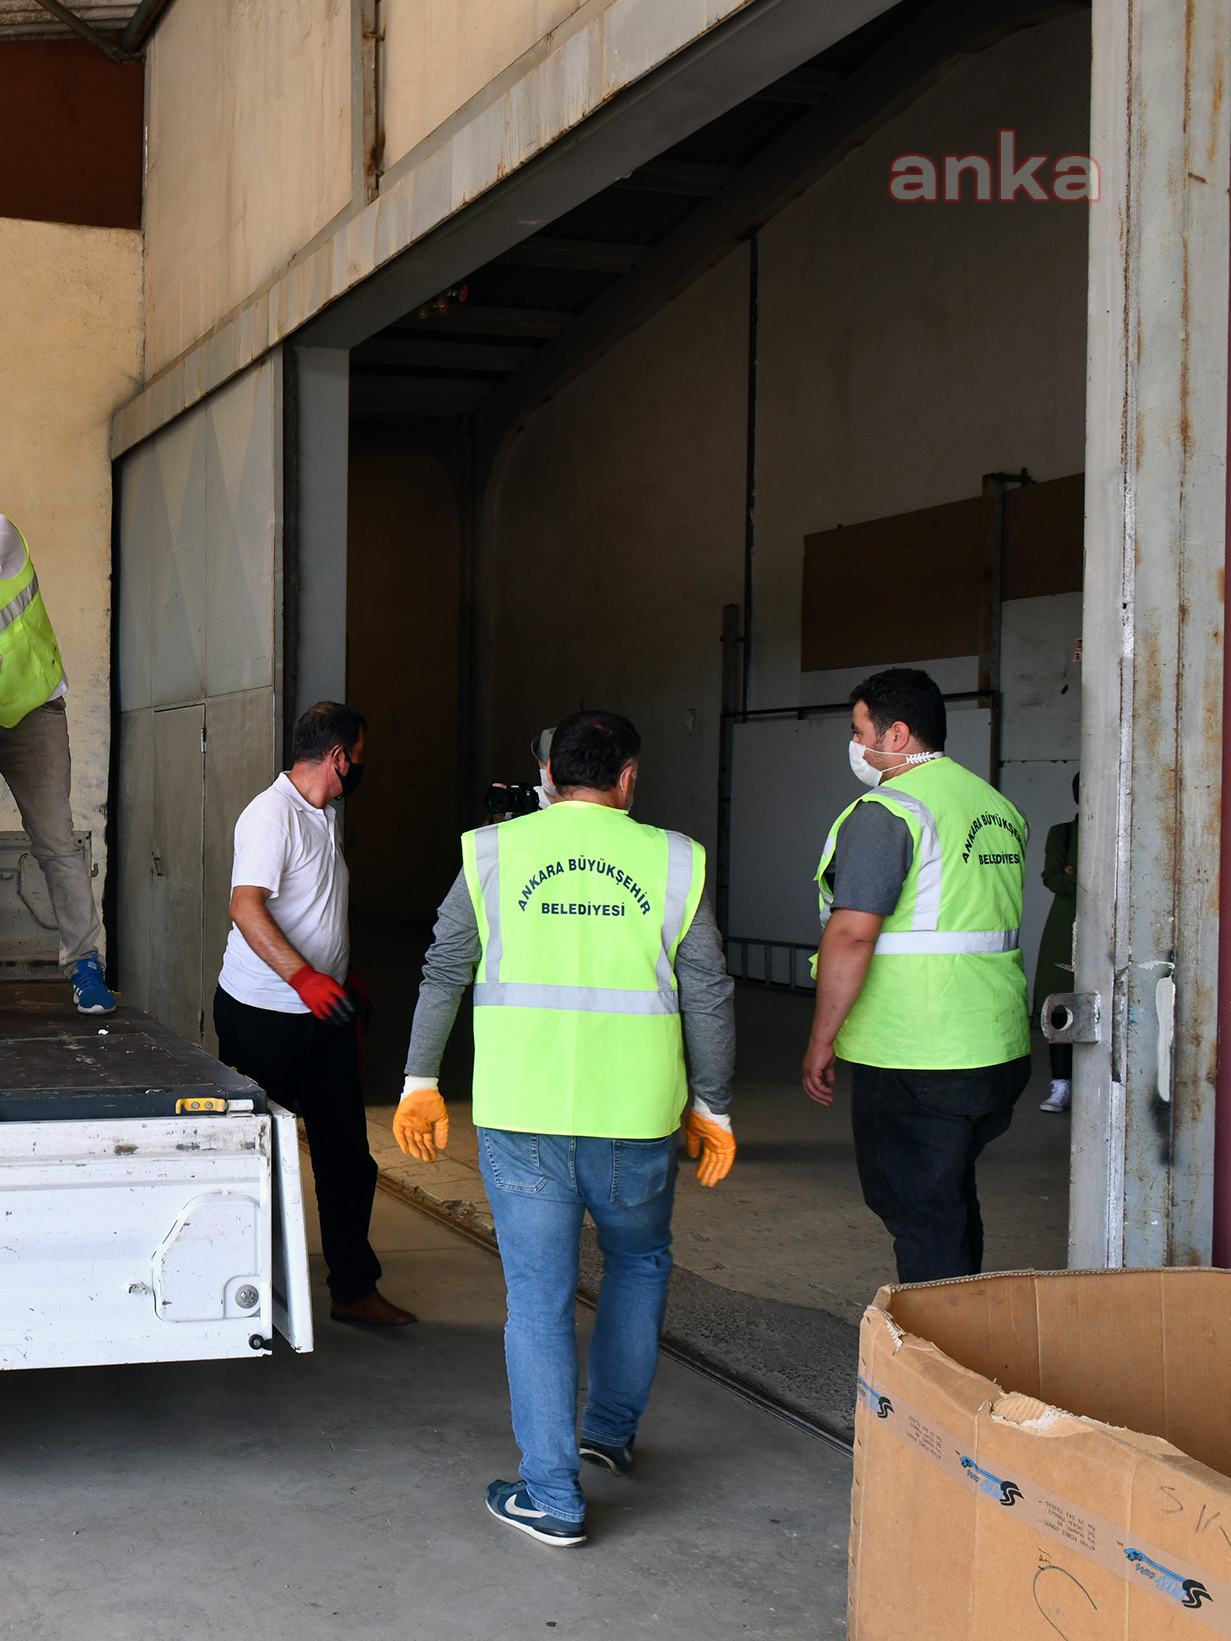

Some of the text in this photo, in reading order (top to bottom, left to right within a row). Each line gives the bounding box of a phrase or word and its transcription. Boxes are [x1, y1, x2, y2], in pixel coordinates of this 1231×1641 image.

[962, 817, 983, 864] ANKARA
[518, 855, 651, 915] ANKARA BÜYÜKŞEHİR
[541, 901, 625, 916] BELEDİYESİ
